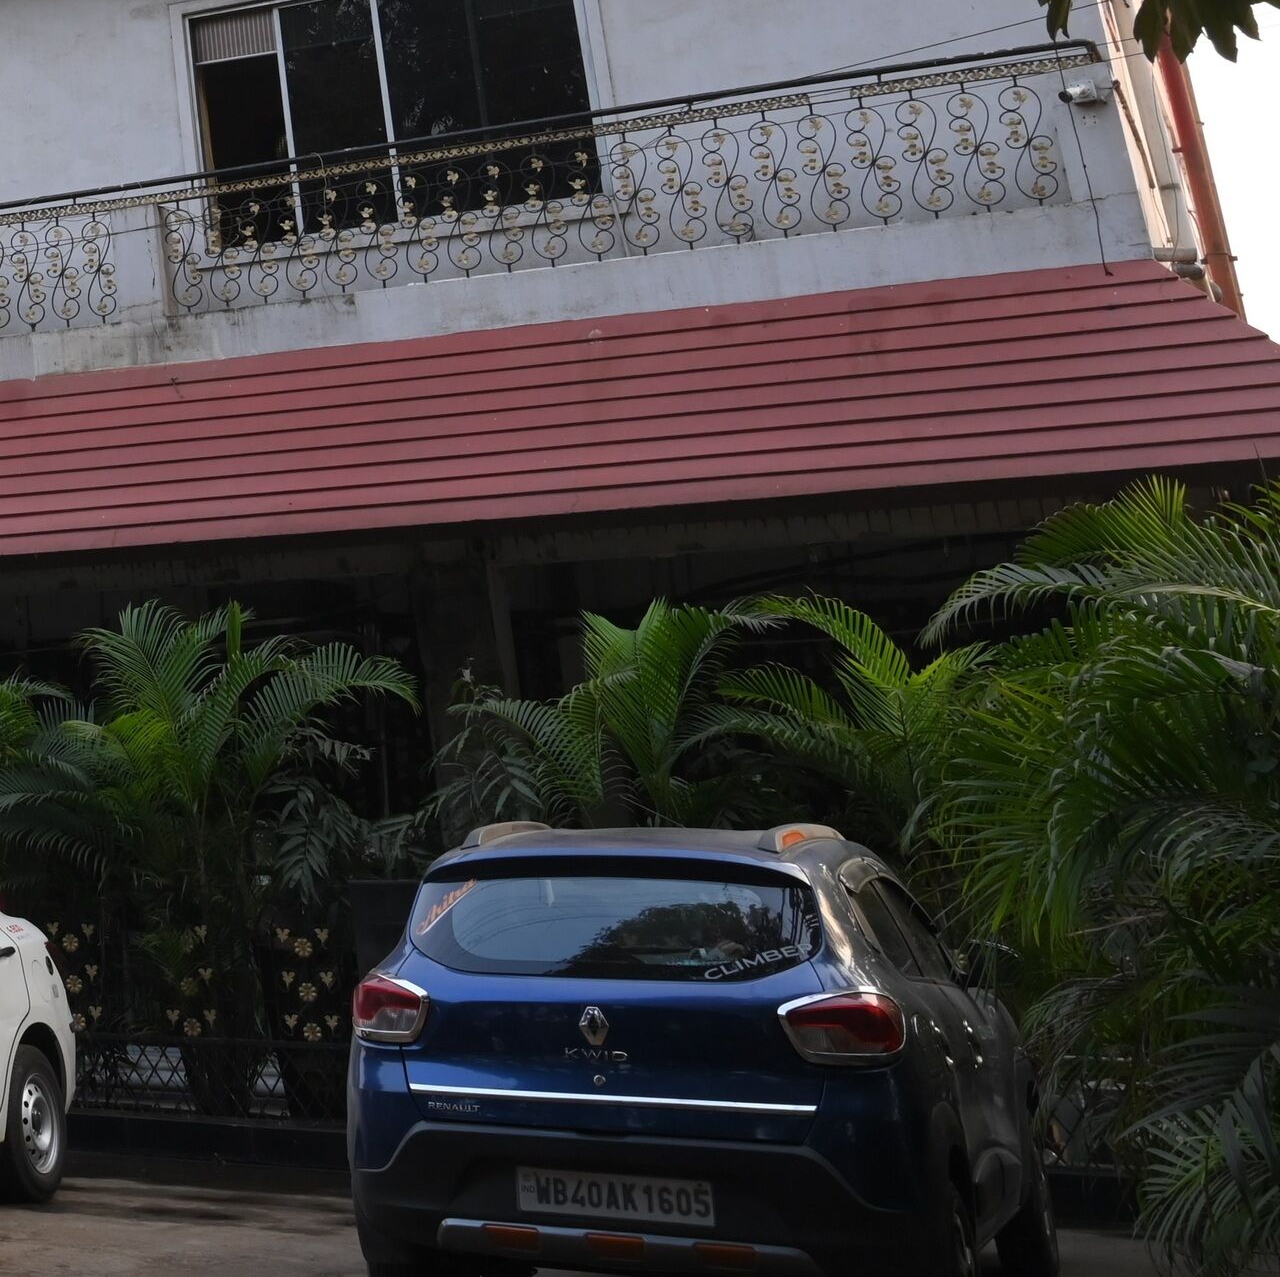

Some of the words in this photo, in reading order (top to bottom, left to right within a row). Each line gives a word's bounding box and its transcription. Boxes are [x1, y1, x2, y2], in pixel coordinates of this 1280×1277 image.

[704, 943, 813, 980] CLIMBER
[564, 1047, 629, 1062] KWID
[427, 1101, 481, 1114] RENAULT
[520, 1183, 535, 1194] IND
[535, 1175, 711, 1219] WB40AK1605
